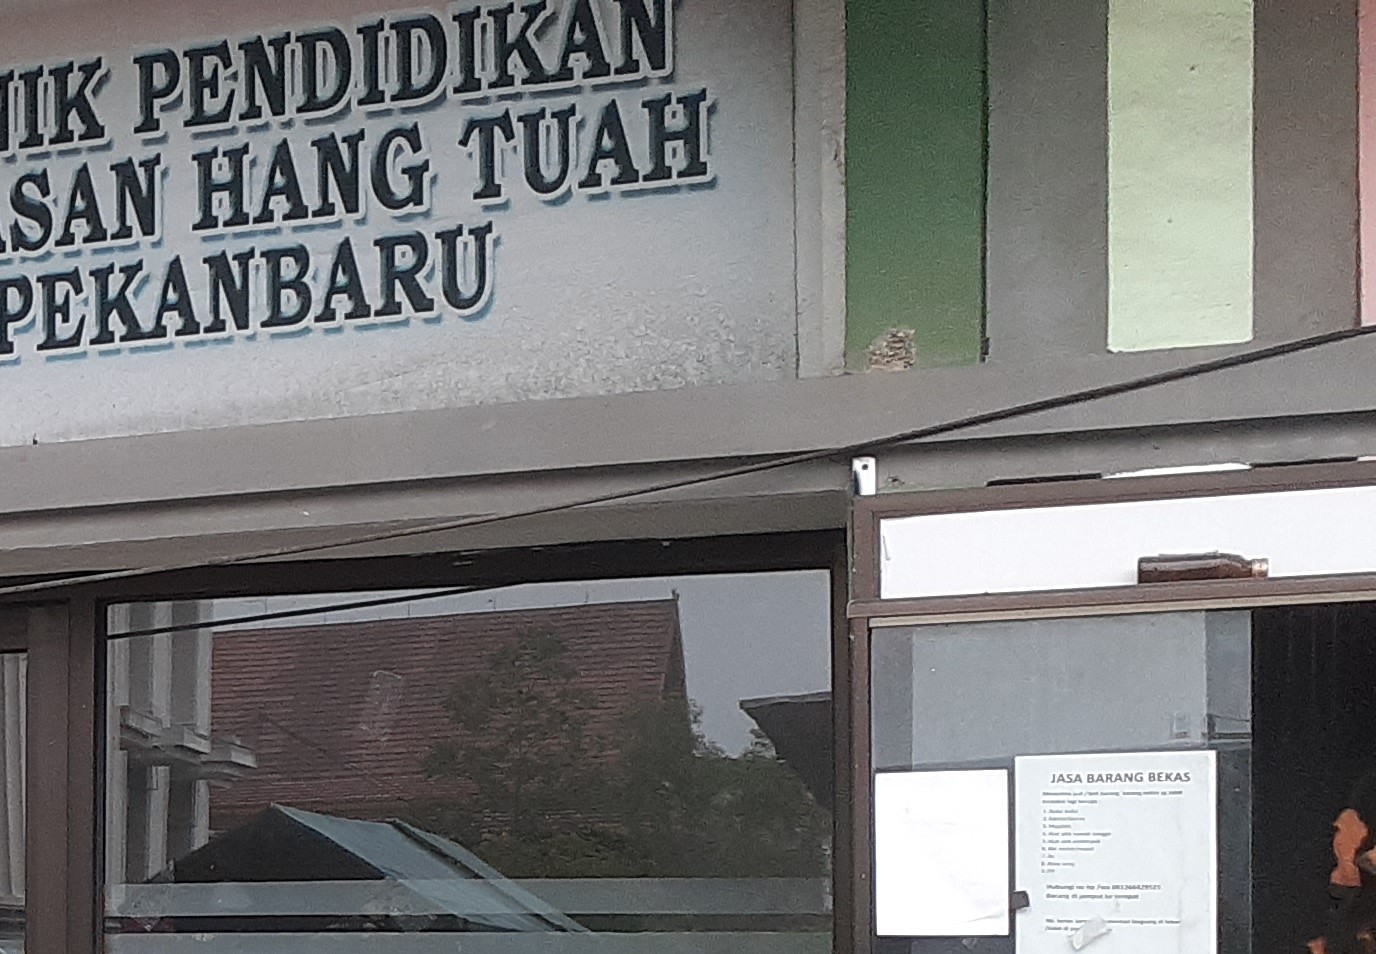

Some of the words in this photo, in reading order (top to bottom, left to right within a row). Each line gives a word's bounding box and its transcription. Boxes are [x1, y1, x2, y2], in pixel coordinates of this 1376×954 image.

[133, 0, 669, 135] PENDIDIKAN
[192, 122, 431, 230] HANG
[458, 88, 709, 200] TUAH
[1051, 773, 1083, 784] JASA
[1086, 772, 1144, 784] BARANG
[1148, 772, 1191, 783] BEKAS
